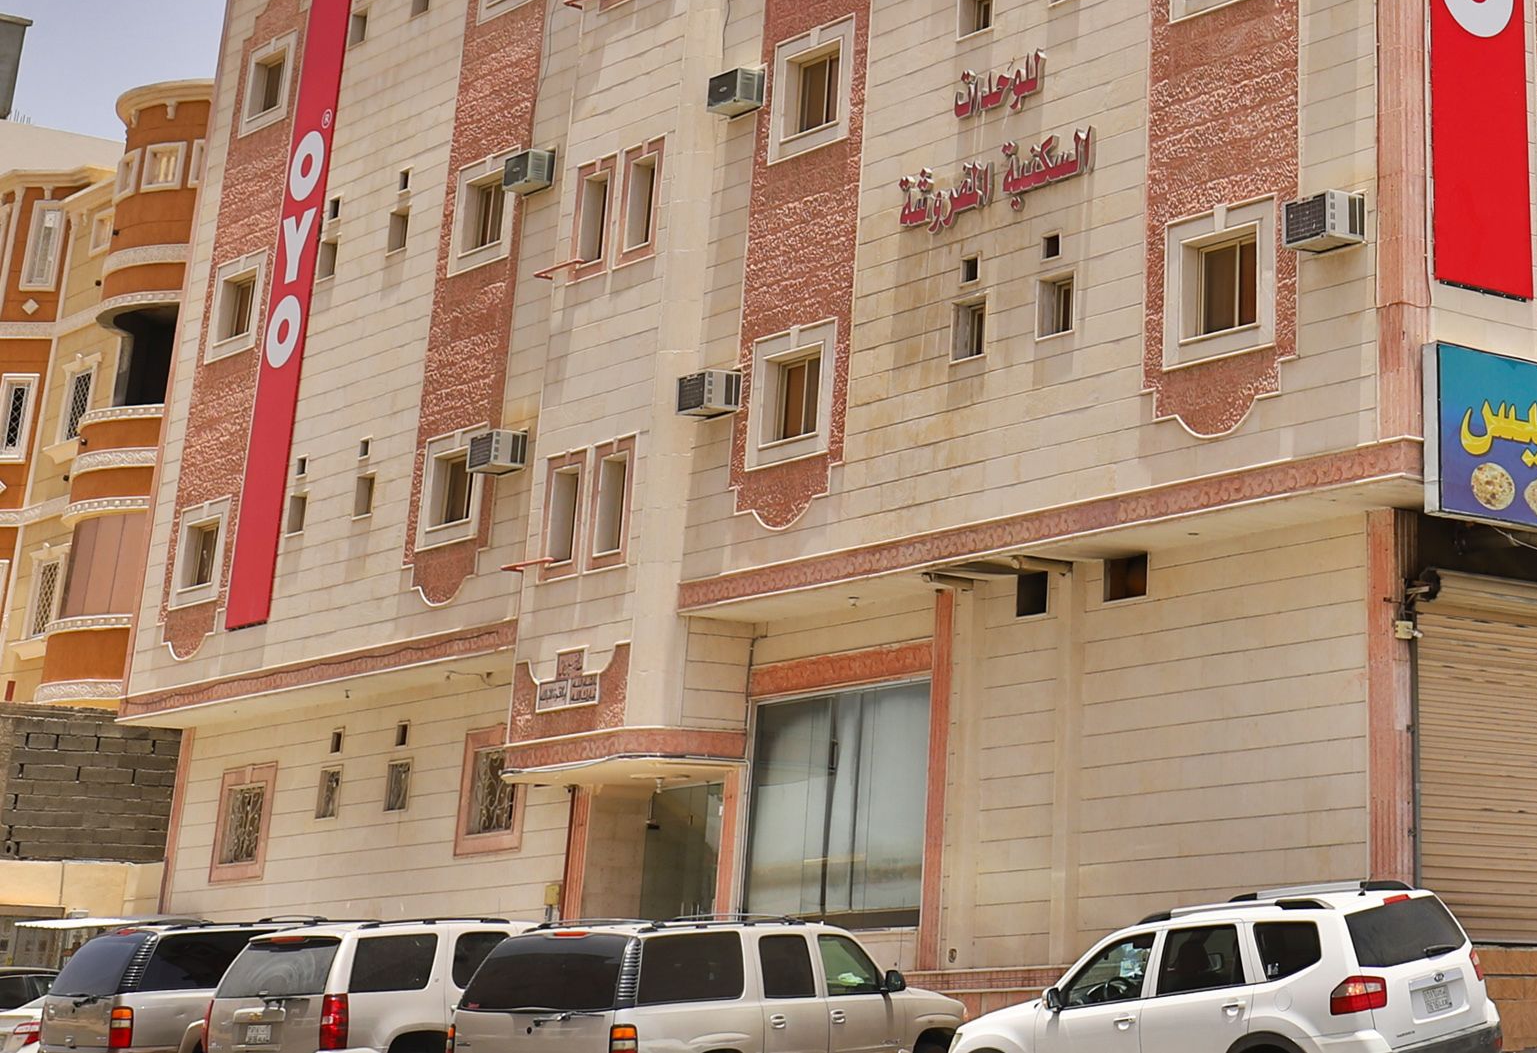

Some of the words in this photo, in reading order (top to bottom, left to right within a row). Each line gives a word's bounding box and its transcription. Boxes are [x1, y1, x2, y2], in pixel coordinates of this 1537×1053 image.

[954, 48, 1047, 119] للوحدات
[899, 160, 995, 234] المفروشة
[1002, 125, 1096, 212] السكنية
[265, 130, 326, 369] OYO
